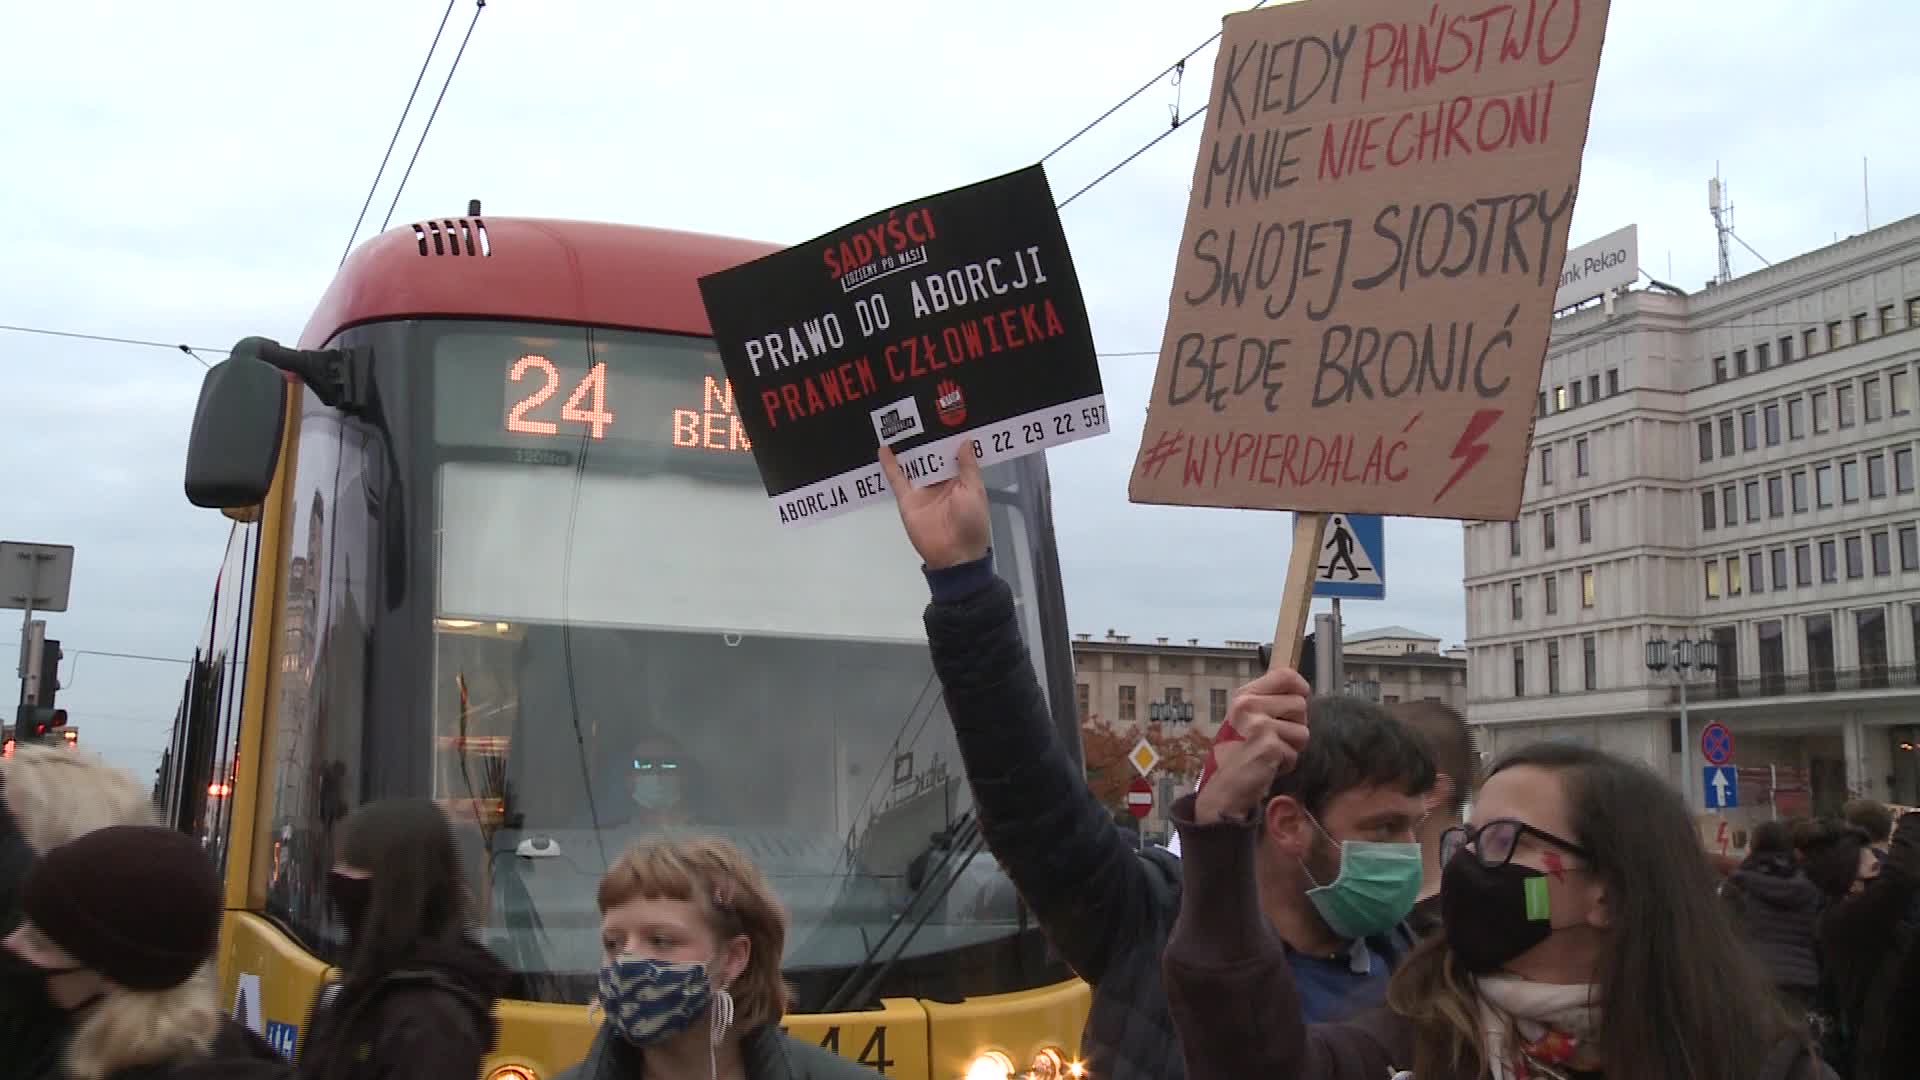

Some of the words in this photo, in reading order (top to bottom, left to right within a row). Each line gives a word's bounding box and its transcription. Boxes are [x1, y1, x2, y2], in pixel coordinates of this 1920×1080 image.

[1217, 25, 1357, 128] KIEDY
[1360, 0, 1581, 100] PAŃSTWO
[1203, 127, 1312, 208] MNIE
[823, 207, 937, 280] SADYŚCI
[881, 256, 895, 271] PO
[1185, 219, 1352, 321] SWOJEJ
[1352, 184, 1577, 291] SIOSTRY
[1560, 264, 1581, 287] ank
[1584, 249, 1627, 279] Pekao
[744, 313, 845, 377] PRAWO
[855, 293, 892, 337] DO
[910, 245, 1048, 319] ABORCJI
[507, 354, 614, 440] 24
[761, 354, 877, 428] PRAWEM
[884, 299, 1065, 382] CZŁOWIEKA
[1168, 332, 1291, 413] BĘDĘ
[1312, 303, 1521, 408] BRONIĆ
[992, 429, 1013, 454] 22
[1023, 419, 1044, 444] 29
[1053, 413, 1075, 435] 22
[1081, 404, 1106, 428] 597
[1141, 412, 1425, 488] #WYPIERDALAĆ
[778, 484, 849, 525] ABORCJA
[855, 471, 886, 501] BEZ
[898, 453, 945, 481] ANIC:
